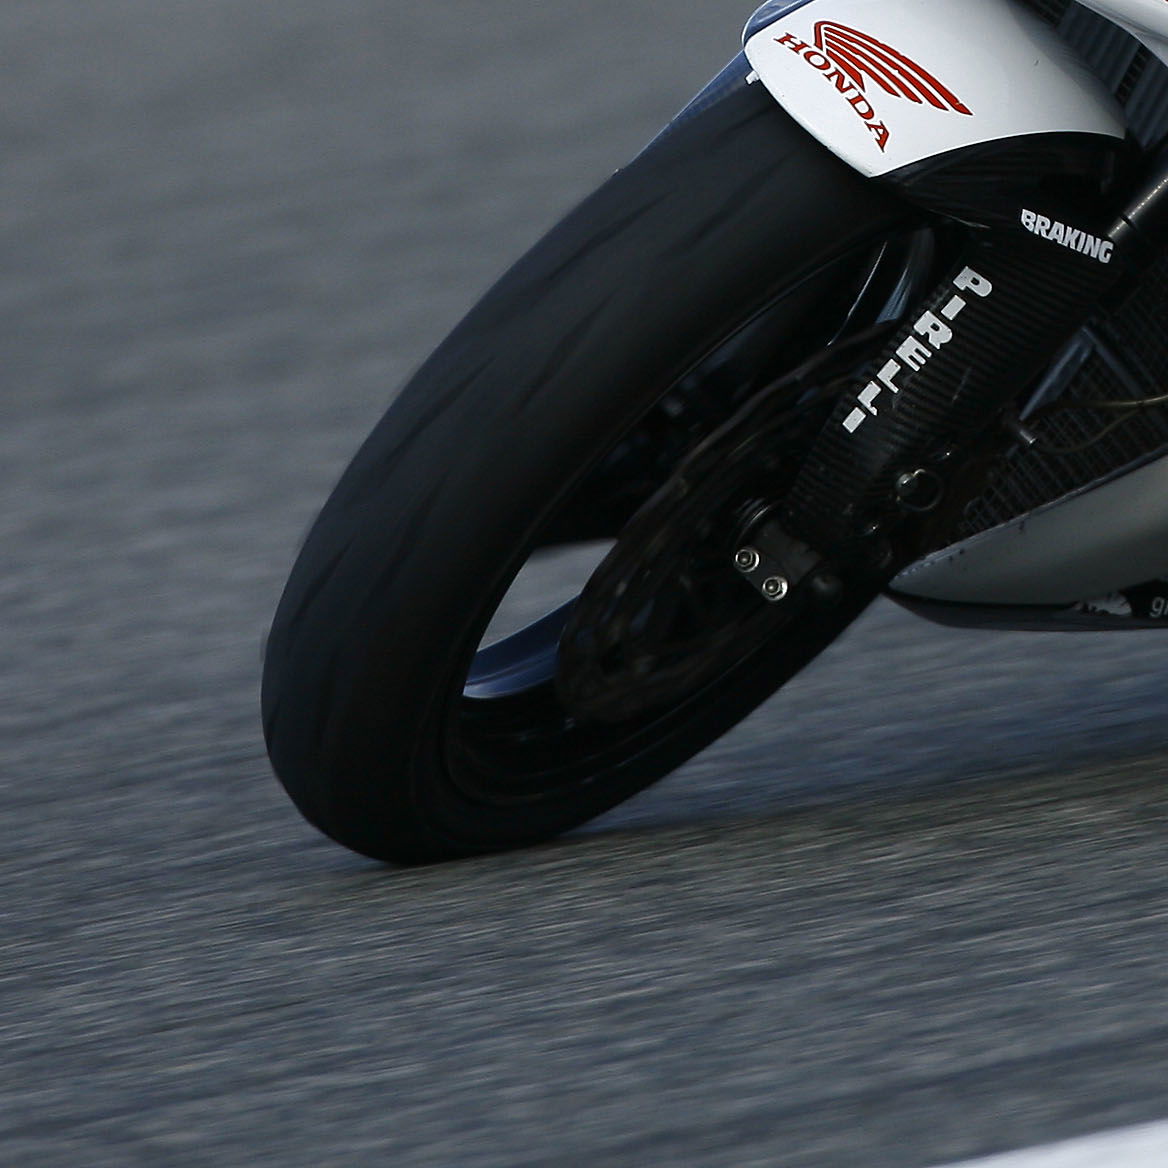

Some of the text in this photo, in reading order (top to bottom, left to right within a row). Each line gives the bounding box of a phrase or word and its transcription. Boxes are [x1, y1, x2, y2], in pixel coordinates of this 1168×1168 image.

[773, 32, 890, 153] HONDA
[1020, 208, 1114, 264] BRAKING
[842, 266, 993, 433] PIRELLI
